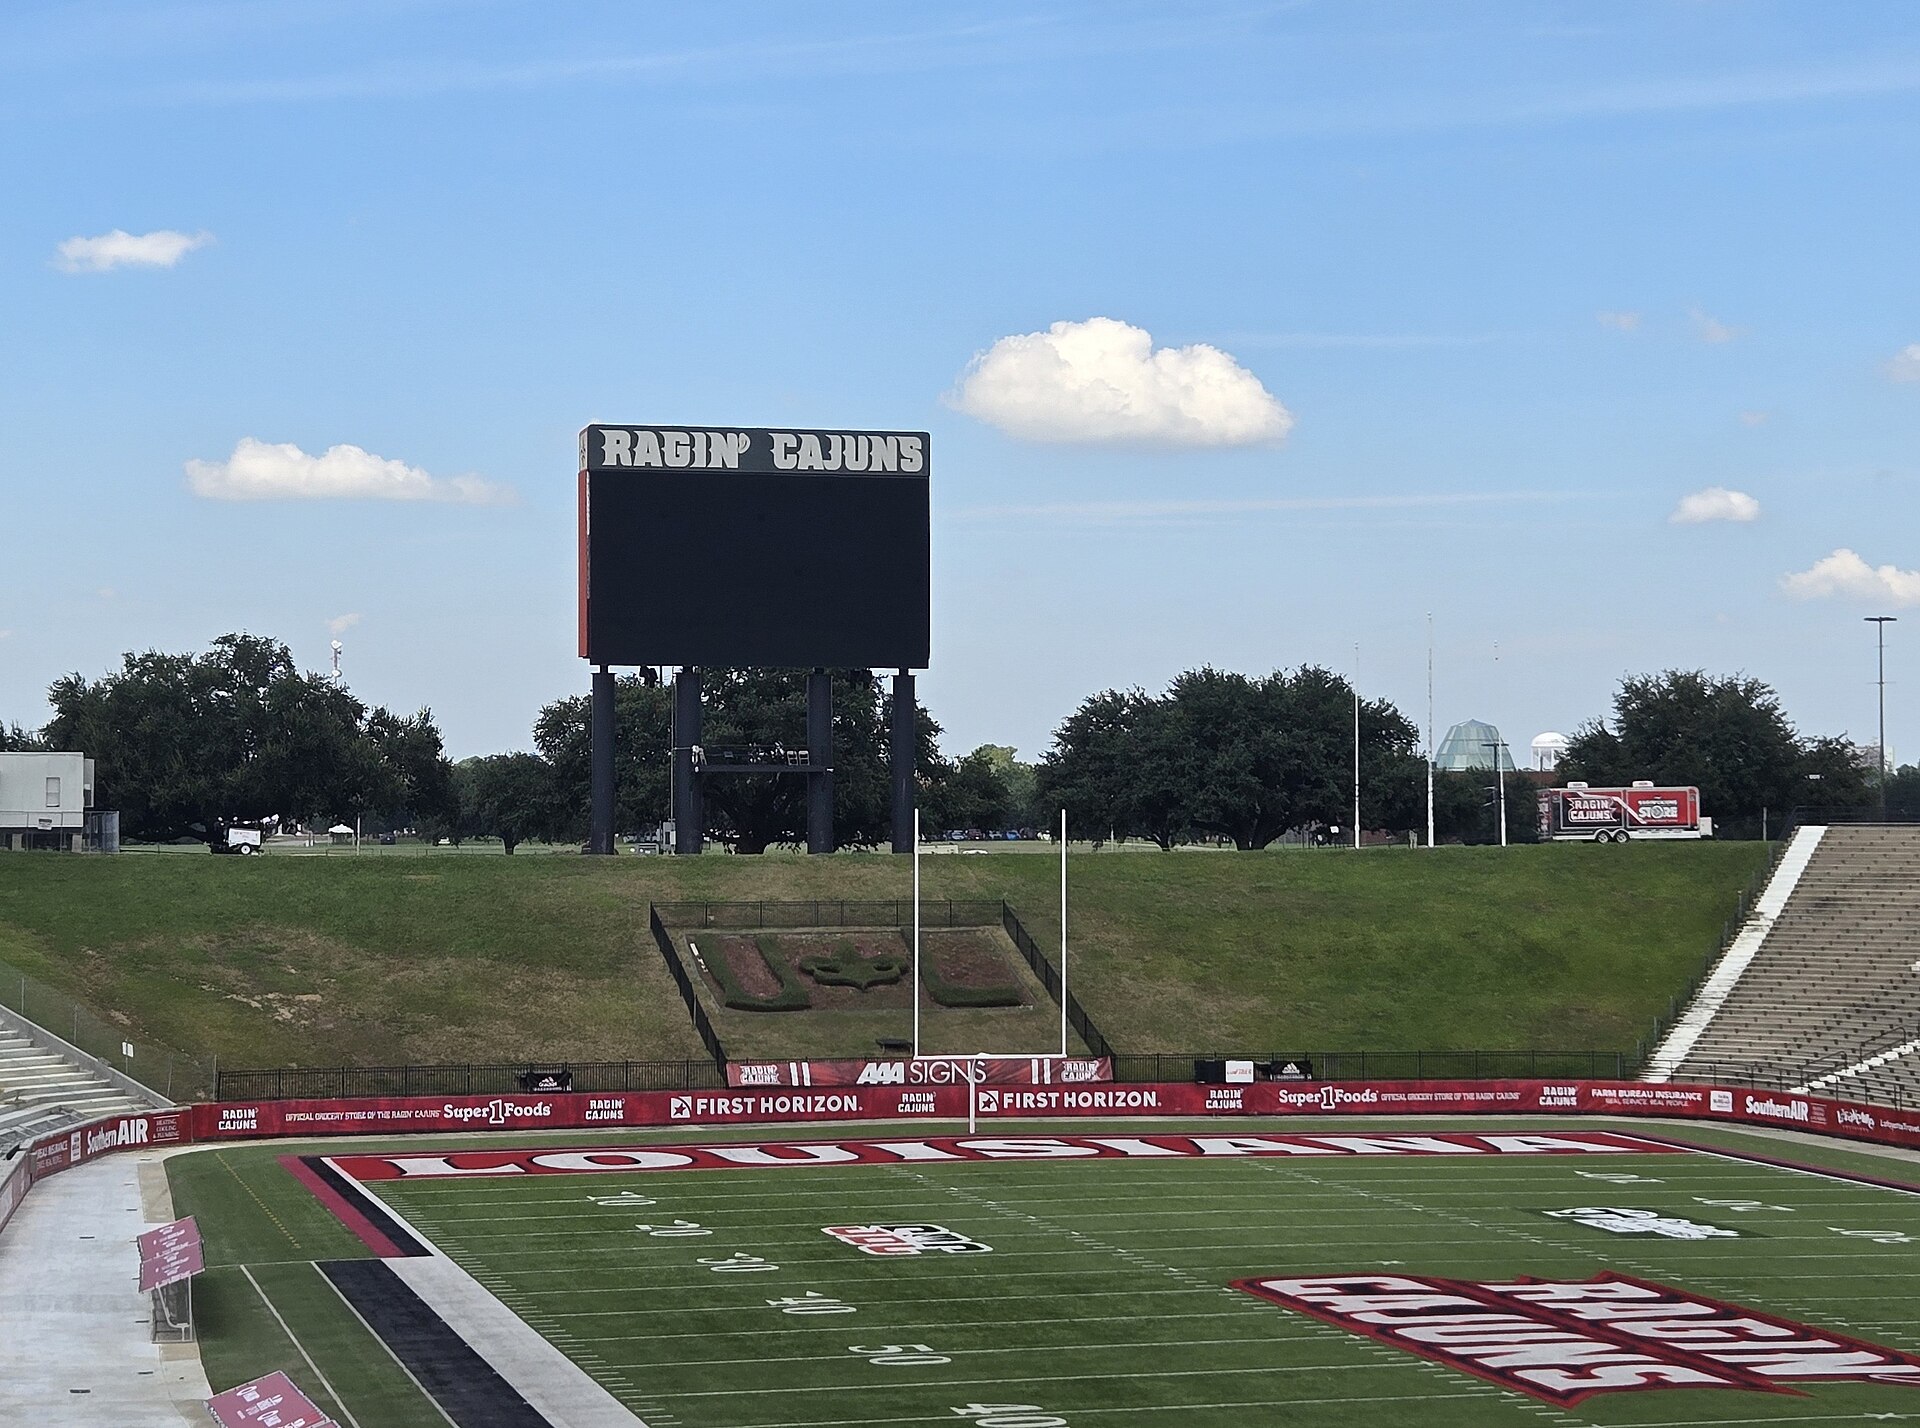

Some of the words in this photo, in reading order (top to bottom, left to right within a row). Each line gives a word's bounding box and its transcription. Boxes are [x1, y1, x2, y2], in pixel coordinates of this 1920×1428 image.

[599, 429, 750, 468] RAGIN'
[768, 433, 923, 472] CAJUNS
[1570, 810, 1611, 820] CAJUNS
[1638, 805, 1678, 818] STORE
[857, 1062, 905, 1084] AAA
[910, 1060, 987, 1084] SIGNS
[1003, 1092, 1059, 1108] FIRST
[1538, 1096, 1577, 1106] CAJUNS
[1591, 1088, 1617, 1098] FARM
[1618, 1089, 1654, 1098] BUREAU
[1655, 1090, 1703, 1101] INSURANCE
[696, 1097, 756, 1115] FIRST
[898, 1103, 935, 1113] CAJUNS
[1205, 1099, 1243, 1109] CAJUNS
[585, 1110, 624, 1121] CAJUNS
[218, 1120, 258, 1131] CAJUNS
[383, 1136, 1642, 1176] LOUISIANA
[1259, 1276, 1735, 1391] CAJUNS
[848, 1344, 952, 1366] 50
[949, 1403, 1068, 1428] 40
